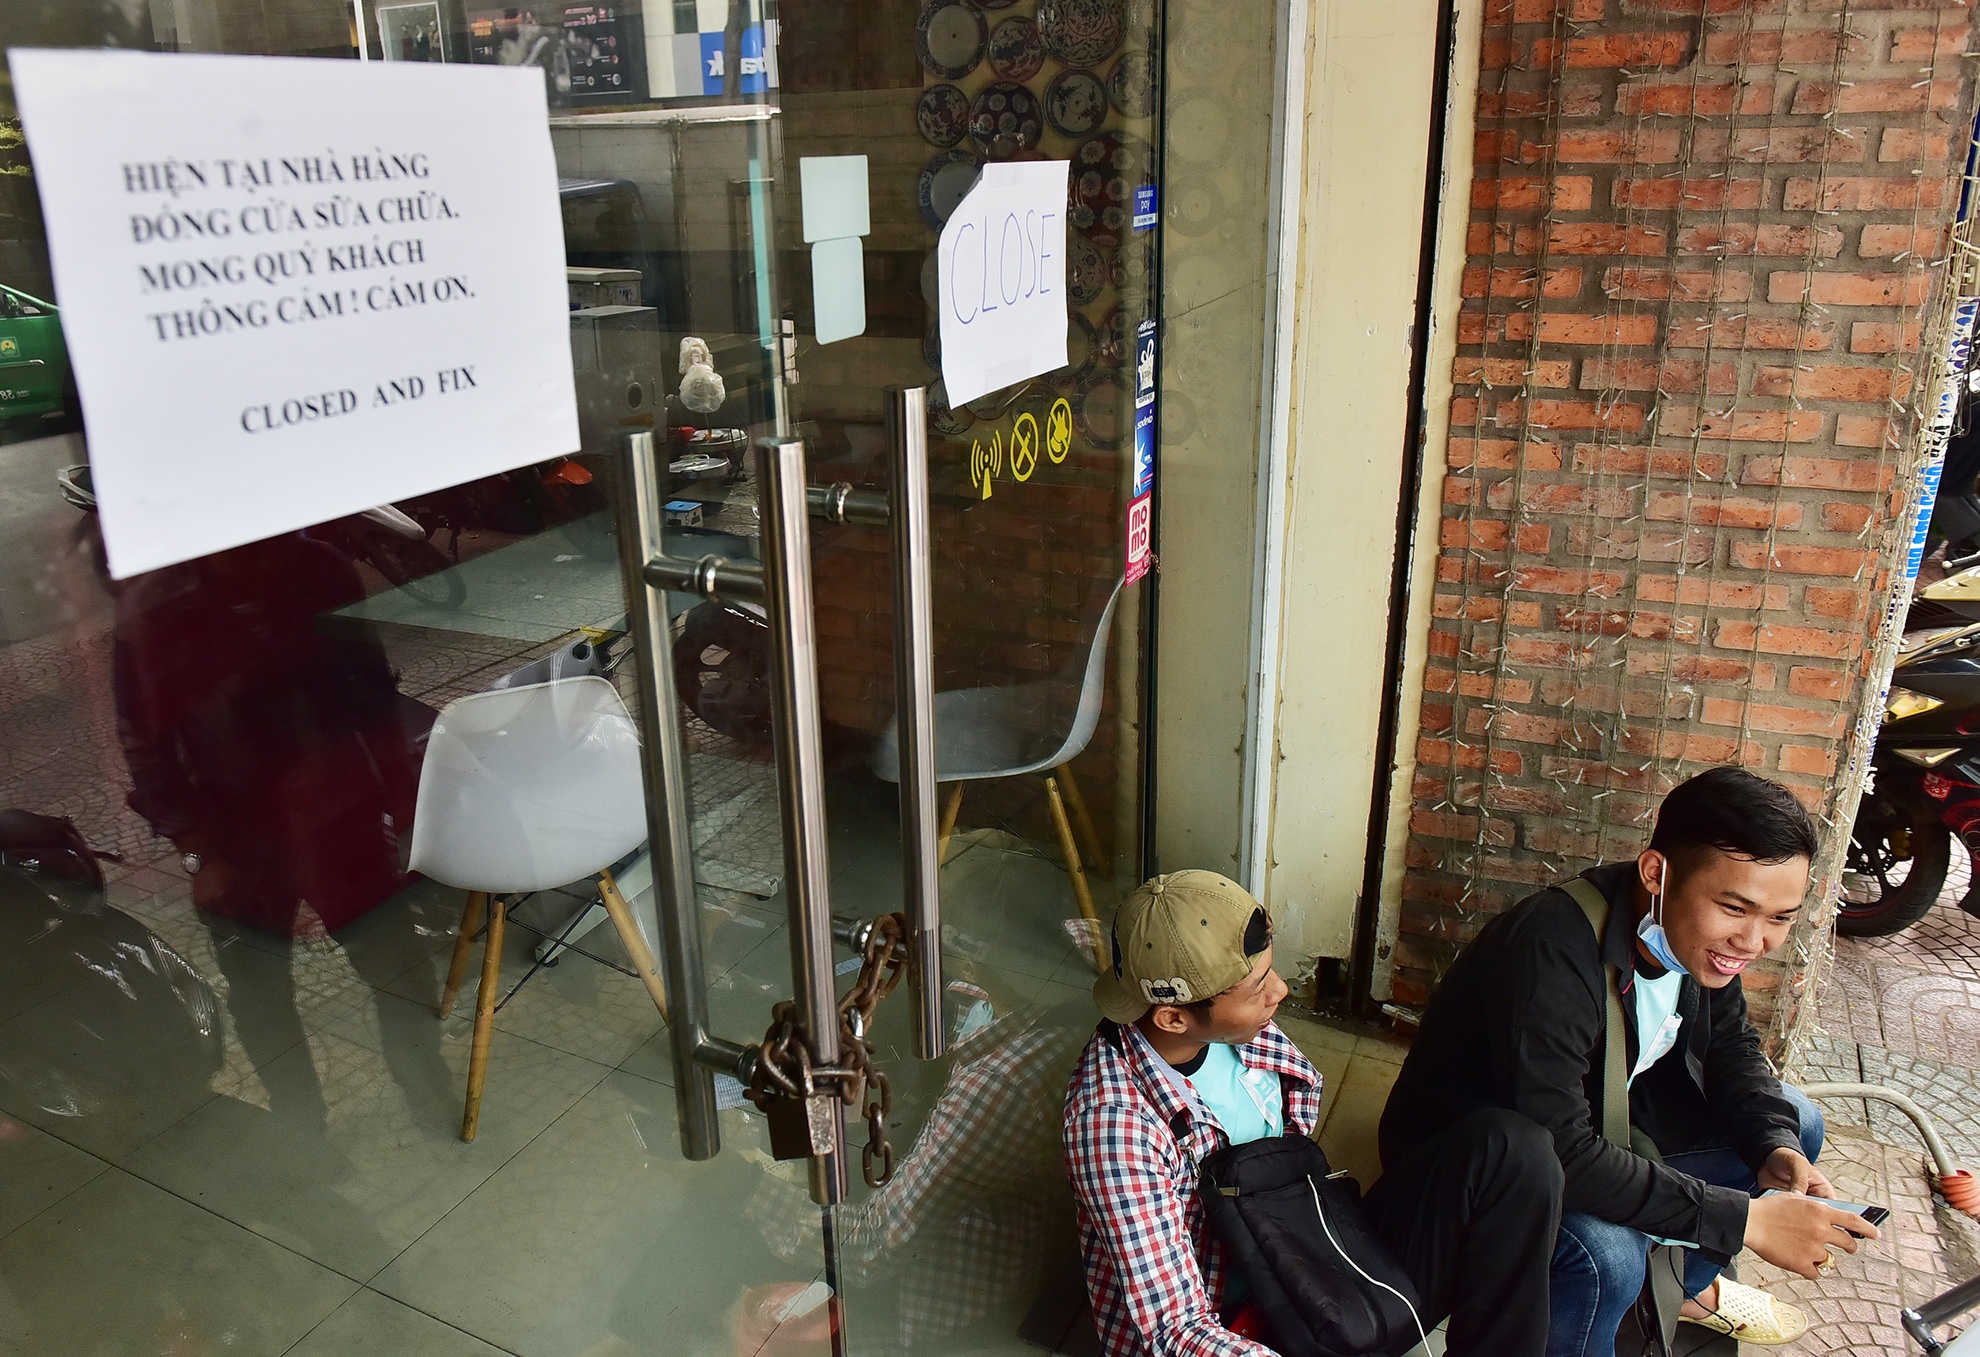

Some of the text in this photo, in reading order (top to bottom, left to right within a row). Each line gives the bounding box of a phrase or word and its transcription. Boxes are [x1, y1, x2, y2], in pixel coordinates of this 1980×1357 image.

[122, 146, 430, 198] HIỆN TẠI NHÀ HÀNG
[129, 189, 460, 244] ĐÓNG CỬA SỮA CHỮA.
[139, 234, 425, 294] MONG QUÝ KHÁCH
[950, 209, 1056, 326] CLOSE
[146, 298, 269, 342] THÔNG
[239, 364, 478, 435] CLOSED AND FIX
